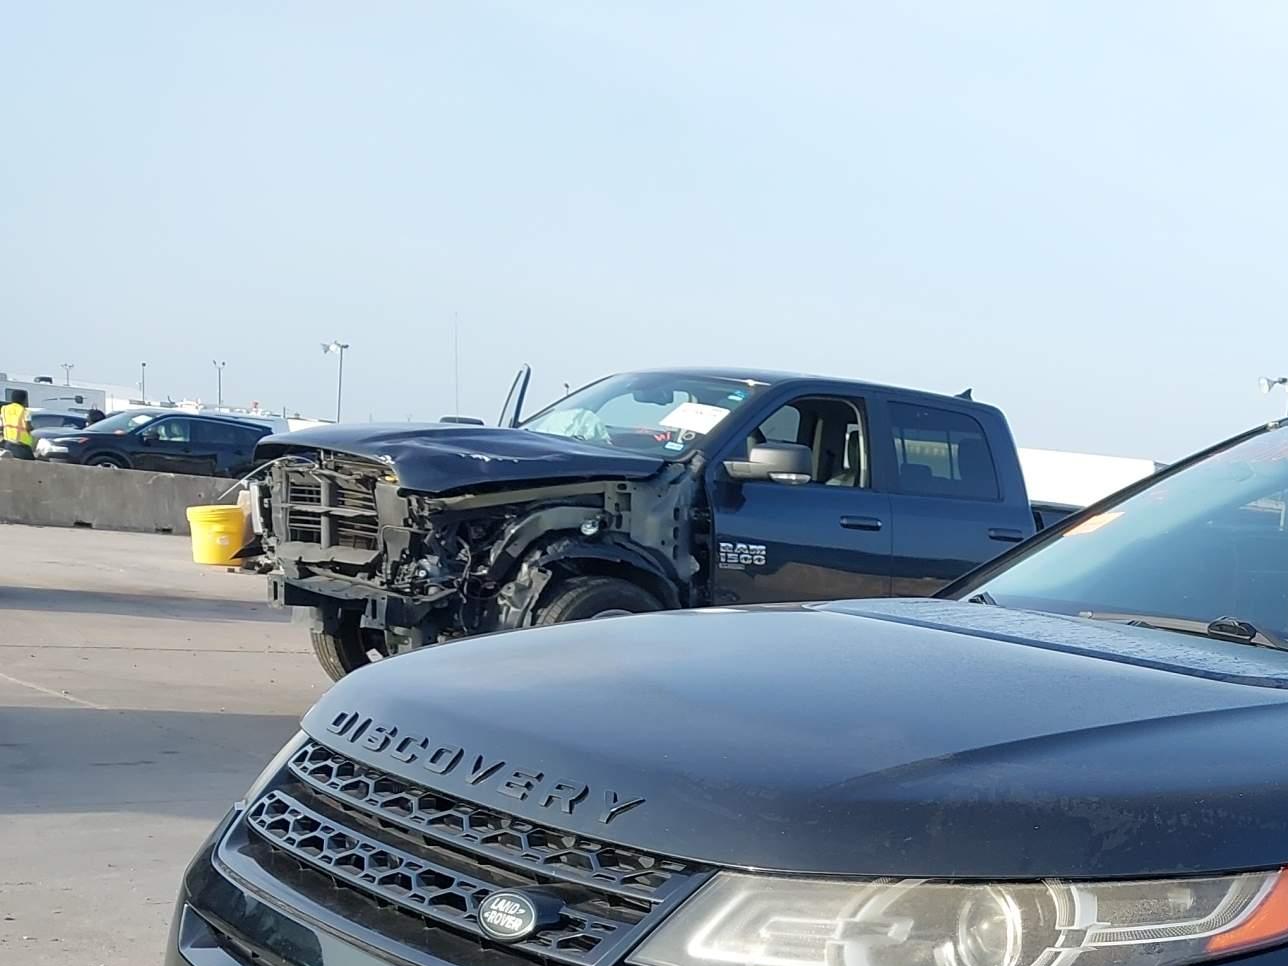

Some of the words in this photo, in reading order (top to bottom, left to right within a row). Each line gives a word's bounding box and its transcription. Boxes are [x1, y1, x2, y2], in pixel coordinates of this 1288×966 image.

[719, 542, 766, 555] RAM
[719, 553, 766, 565] 1500
[327, 711, 647, 824] DISCOVERY
[490, 897, 520, 914] LAND
[486, 910, 523, 931] ROVER
